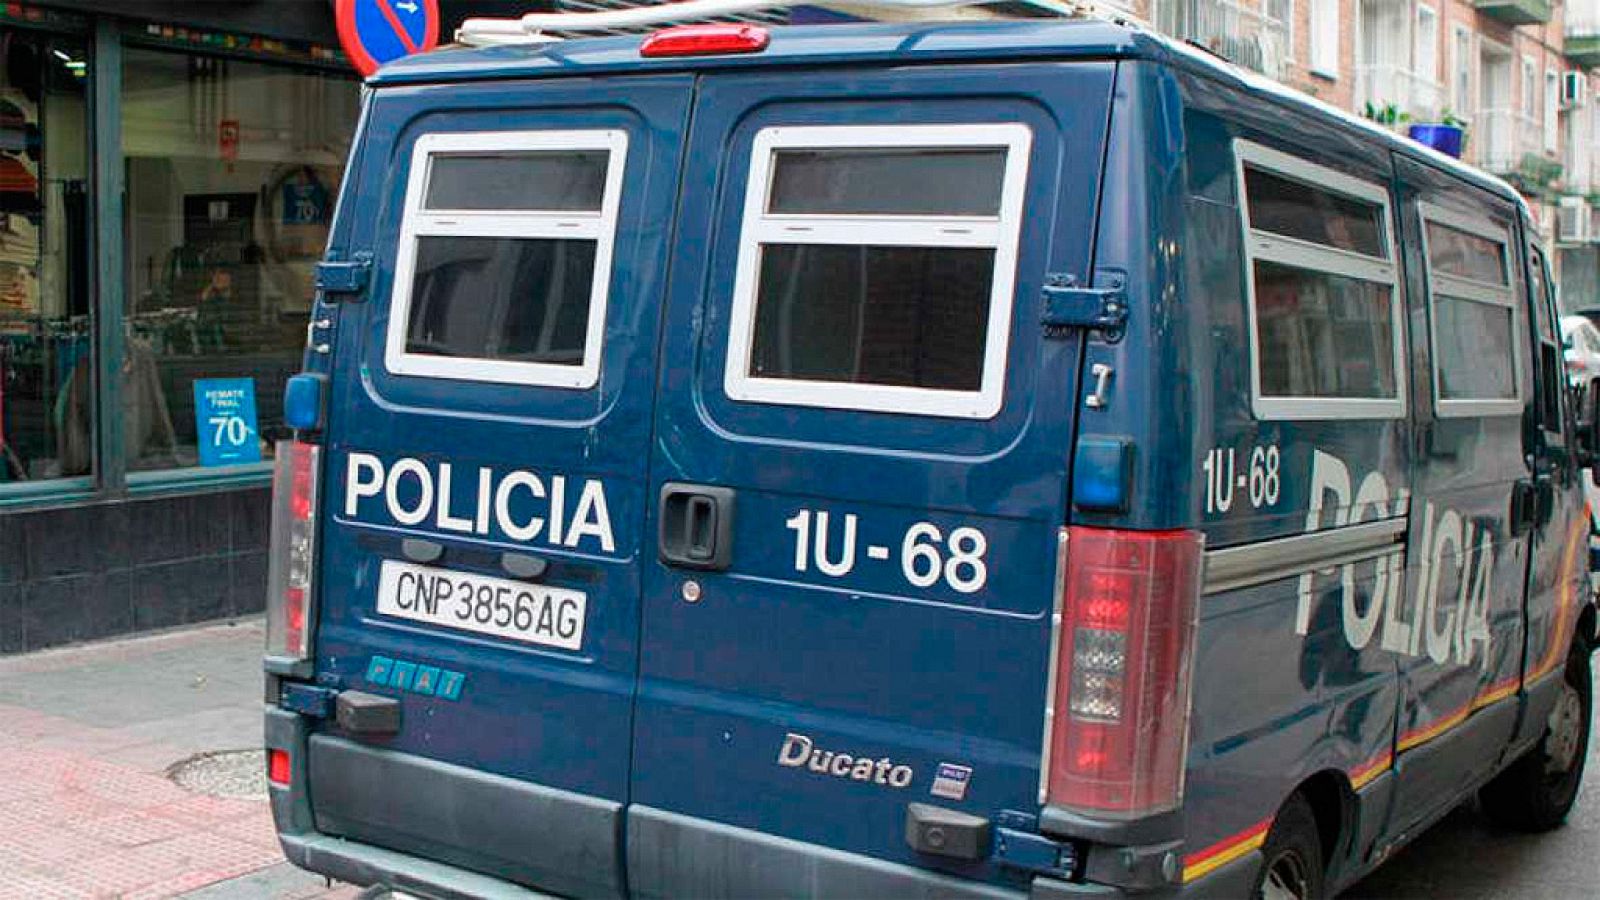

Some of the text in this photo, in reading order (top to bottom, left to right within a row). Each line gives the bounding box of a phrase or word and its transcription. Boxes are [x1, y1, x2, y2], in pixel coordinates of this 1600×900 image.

[345, 452, 615, 552] POLICIA
[1296, 449, 1494, 671] POLICIA
[777, 732, 913, 788] Ducato
